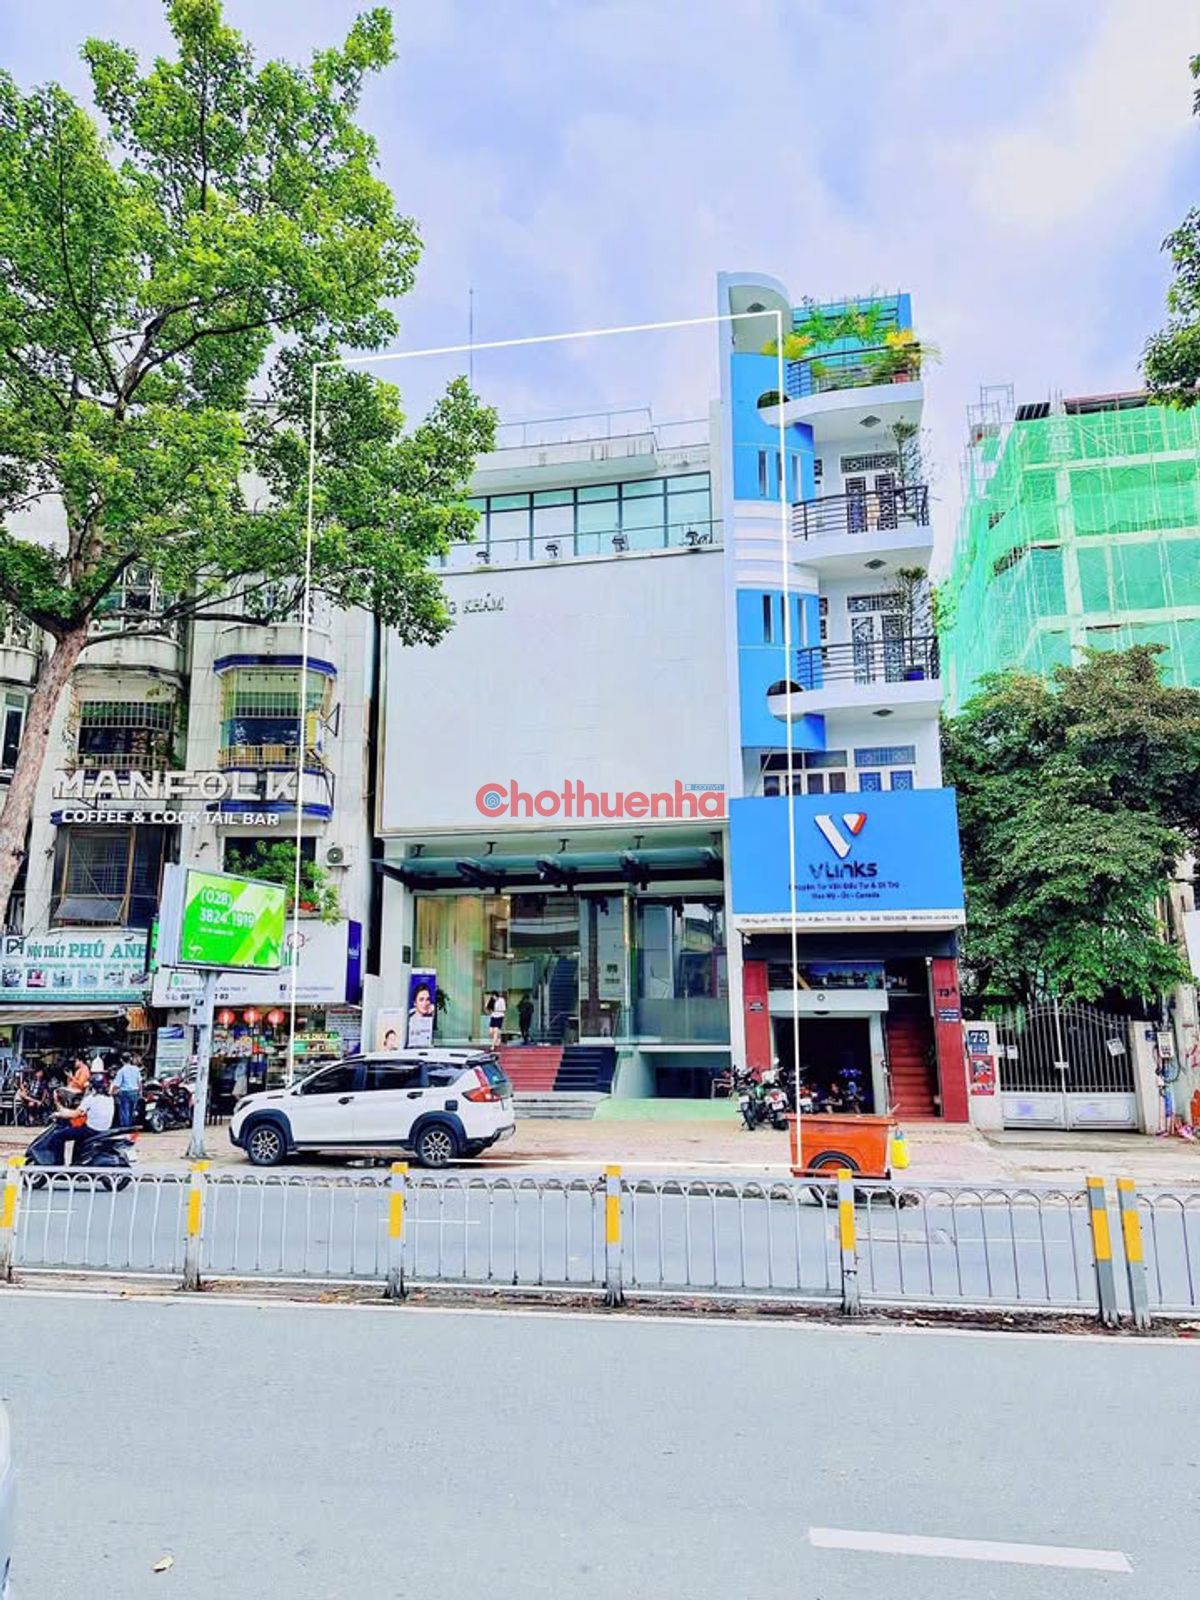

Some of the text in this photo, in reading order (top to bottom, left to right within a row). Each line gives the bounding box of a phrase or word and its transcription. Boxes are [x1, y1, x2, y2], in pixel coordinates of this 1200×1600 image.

[54, 769, 297, 800] MANFOLK
[62, 810, 127, 823] COFFEE
[132, 810, 145, 823] &
[243, 812, 280, 825] BAR
[68, 940, 105, 958] PHÚ
[970, 1032, 988, 1043] 73
